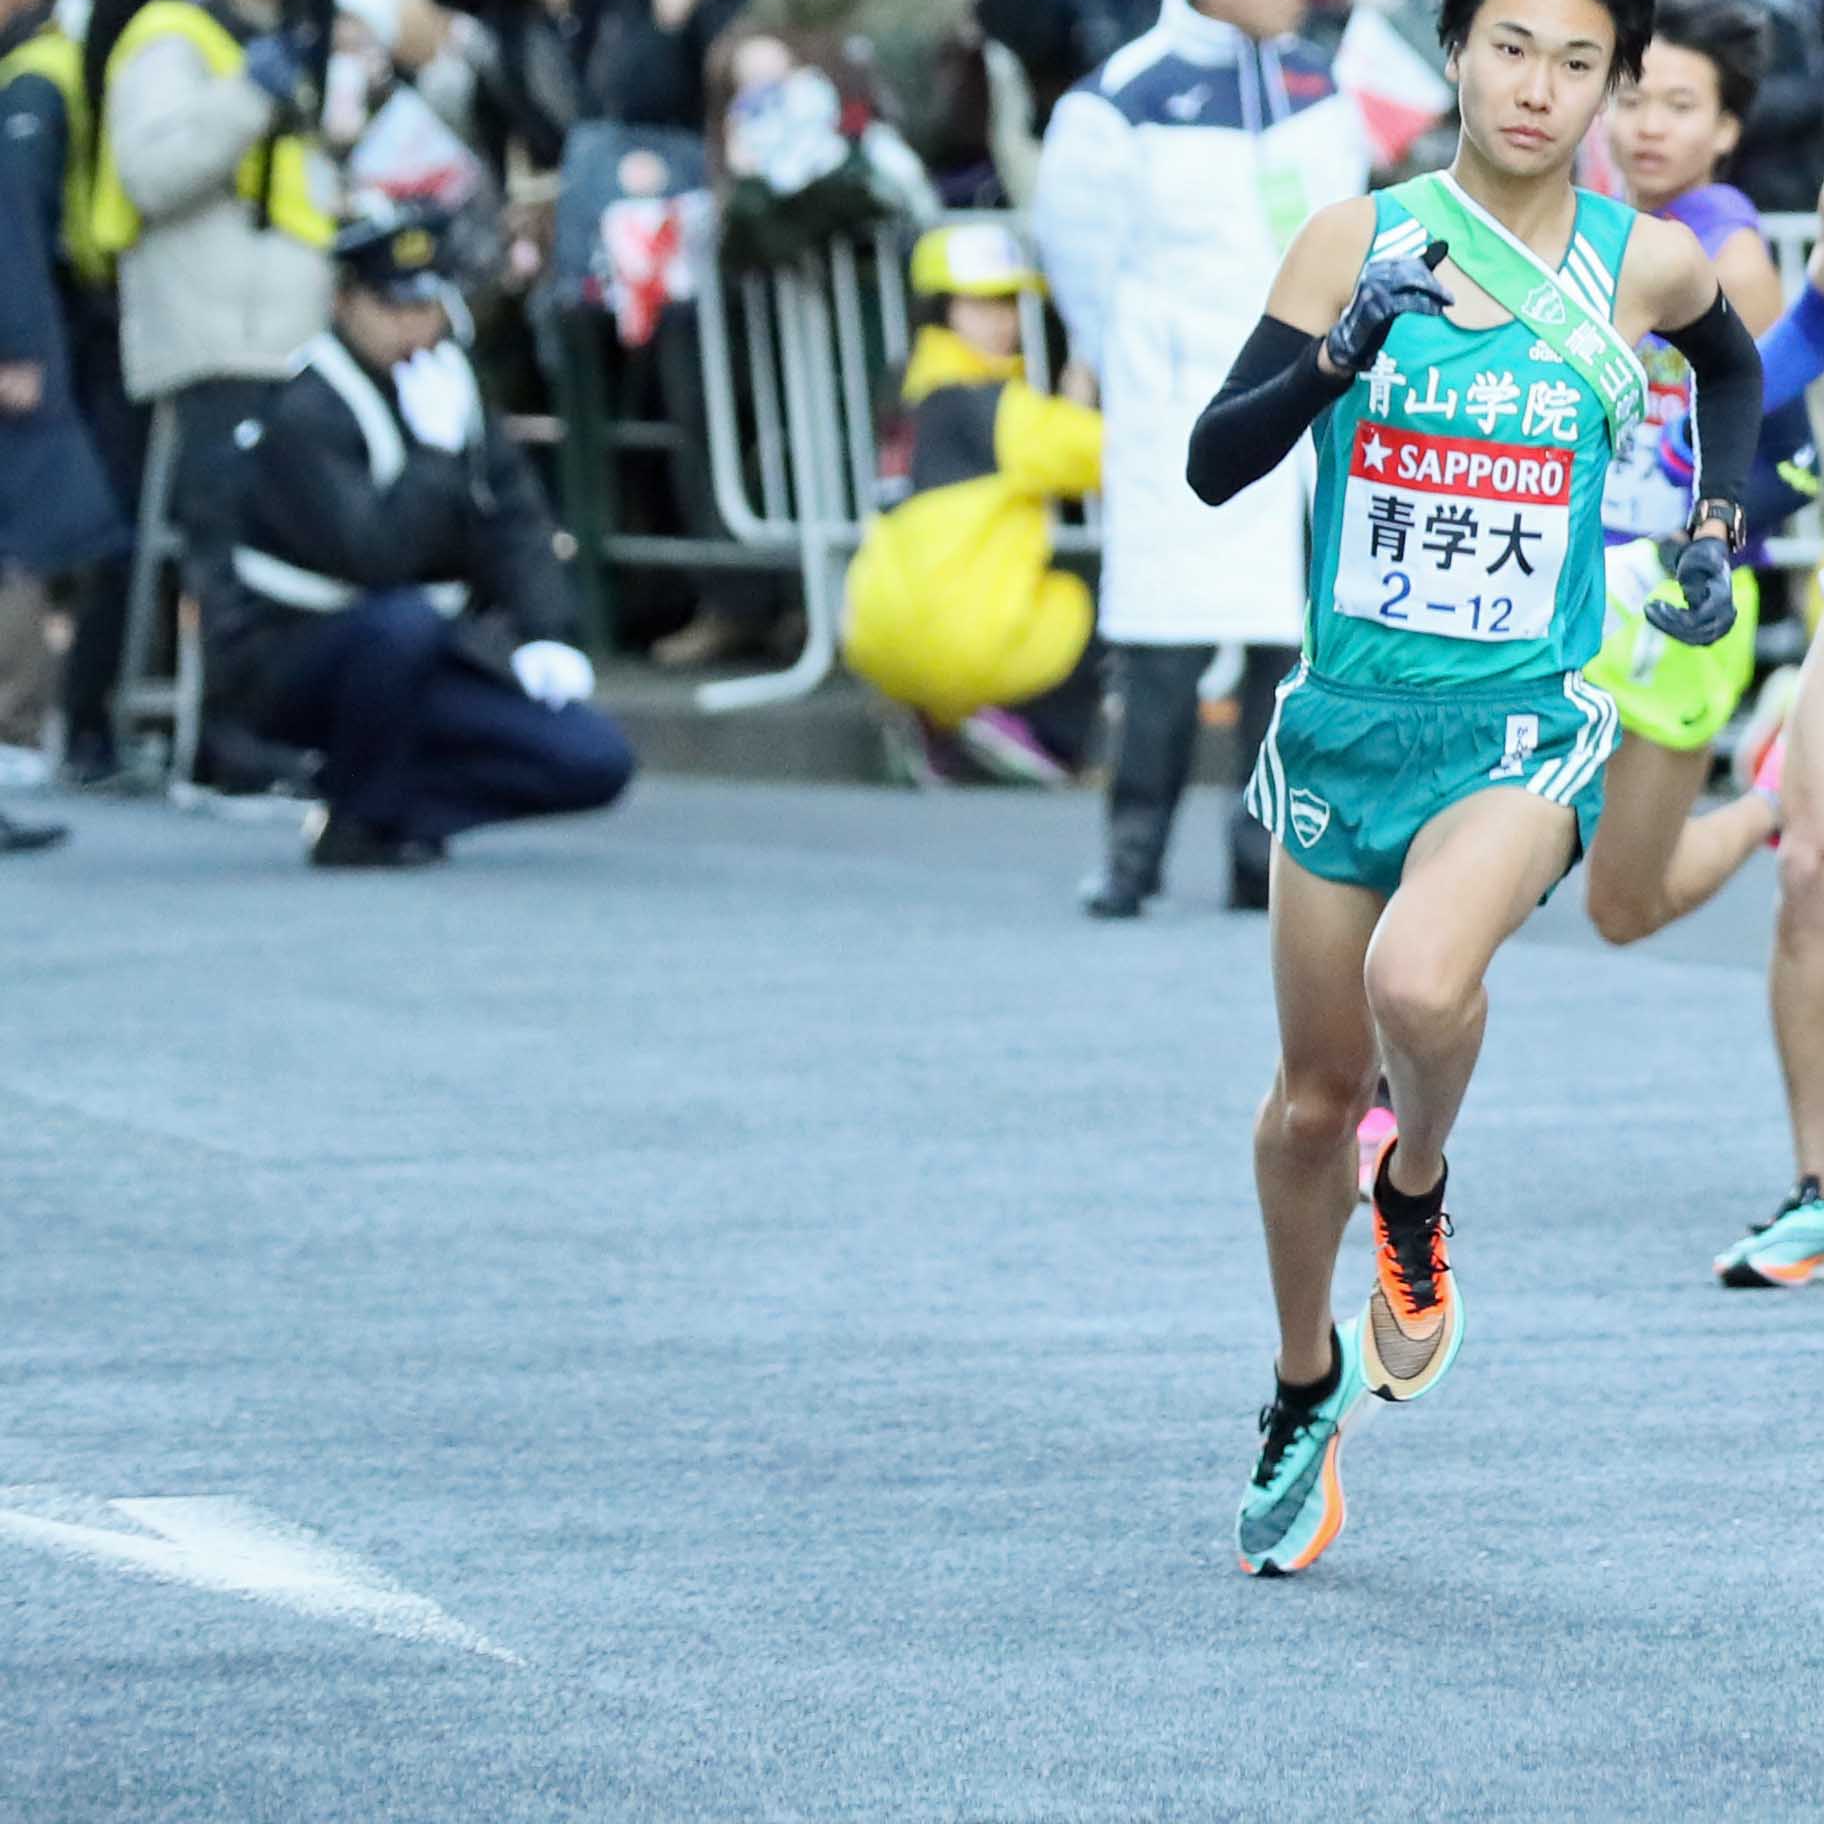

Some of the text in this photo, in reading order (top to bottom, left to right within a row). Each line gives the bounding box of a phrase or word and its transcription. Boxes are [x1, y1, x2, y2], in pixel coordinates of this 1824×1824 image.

[1359, 350, 1580, 442] 青山学院
[1397, 442, 1565, 498] SAPPORO
[1367, 495, 1544, 578] 青学大
[1379, 571, 1515, 634] 2-12
